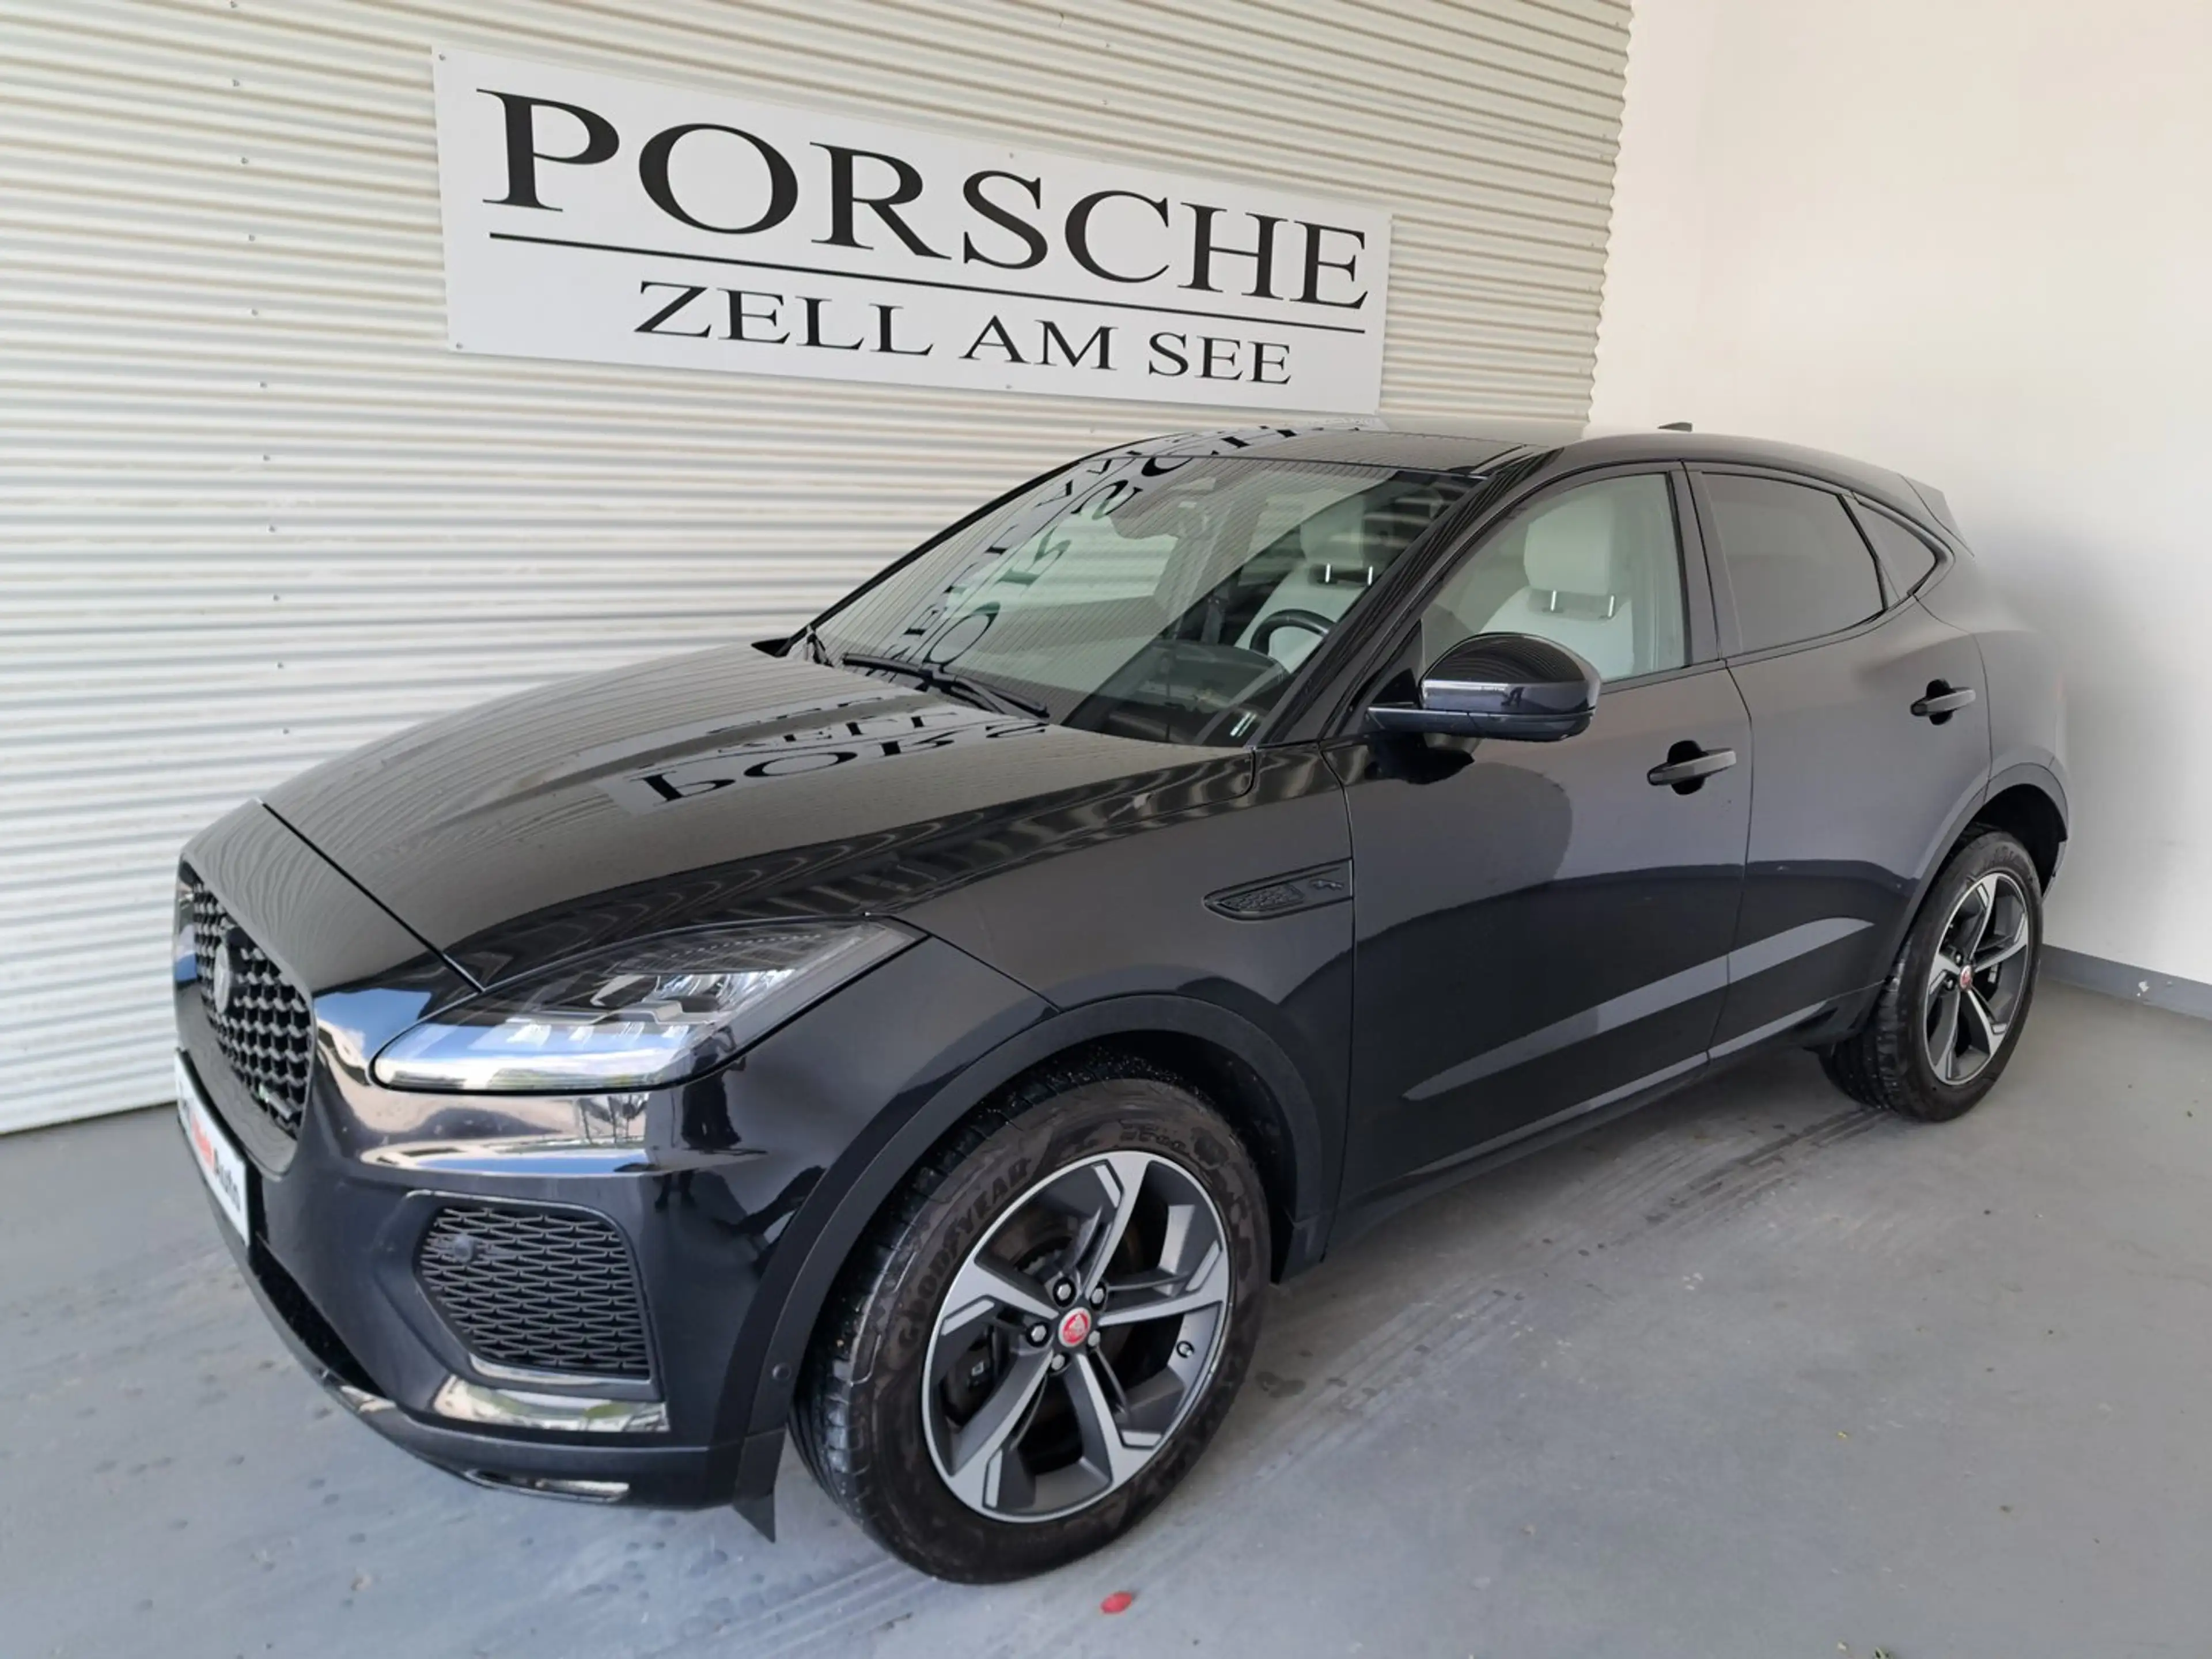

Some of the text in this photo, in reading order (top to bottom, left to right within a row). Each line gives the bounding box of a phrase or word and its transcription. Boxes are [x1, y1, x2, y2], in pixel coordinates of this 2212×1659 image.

[476, 88, 1369, 310] PORSCHE
[634, 281, 1291, 385] ZELL AM SEE
[897, 1157, 1031, 1345] GOODYEAR
